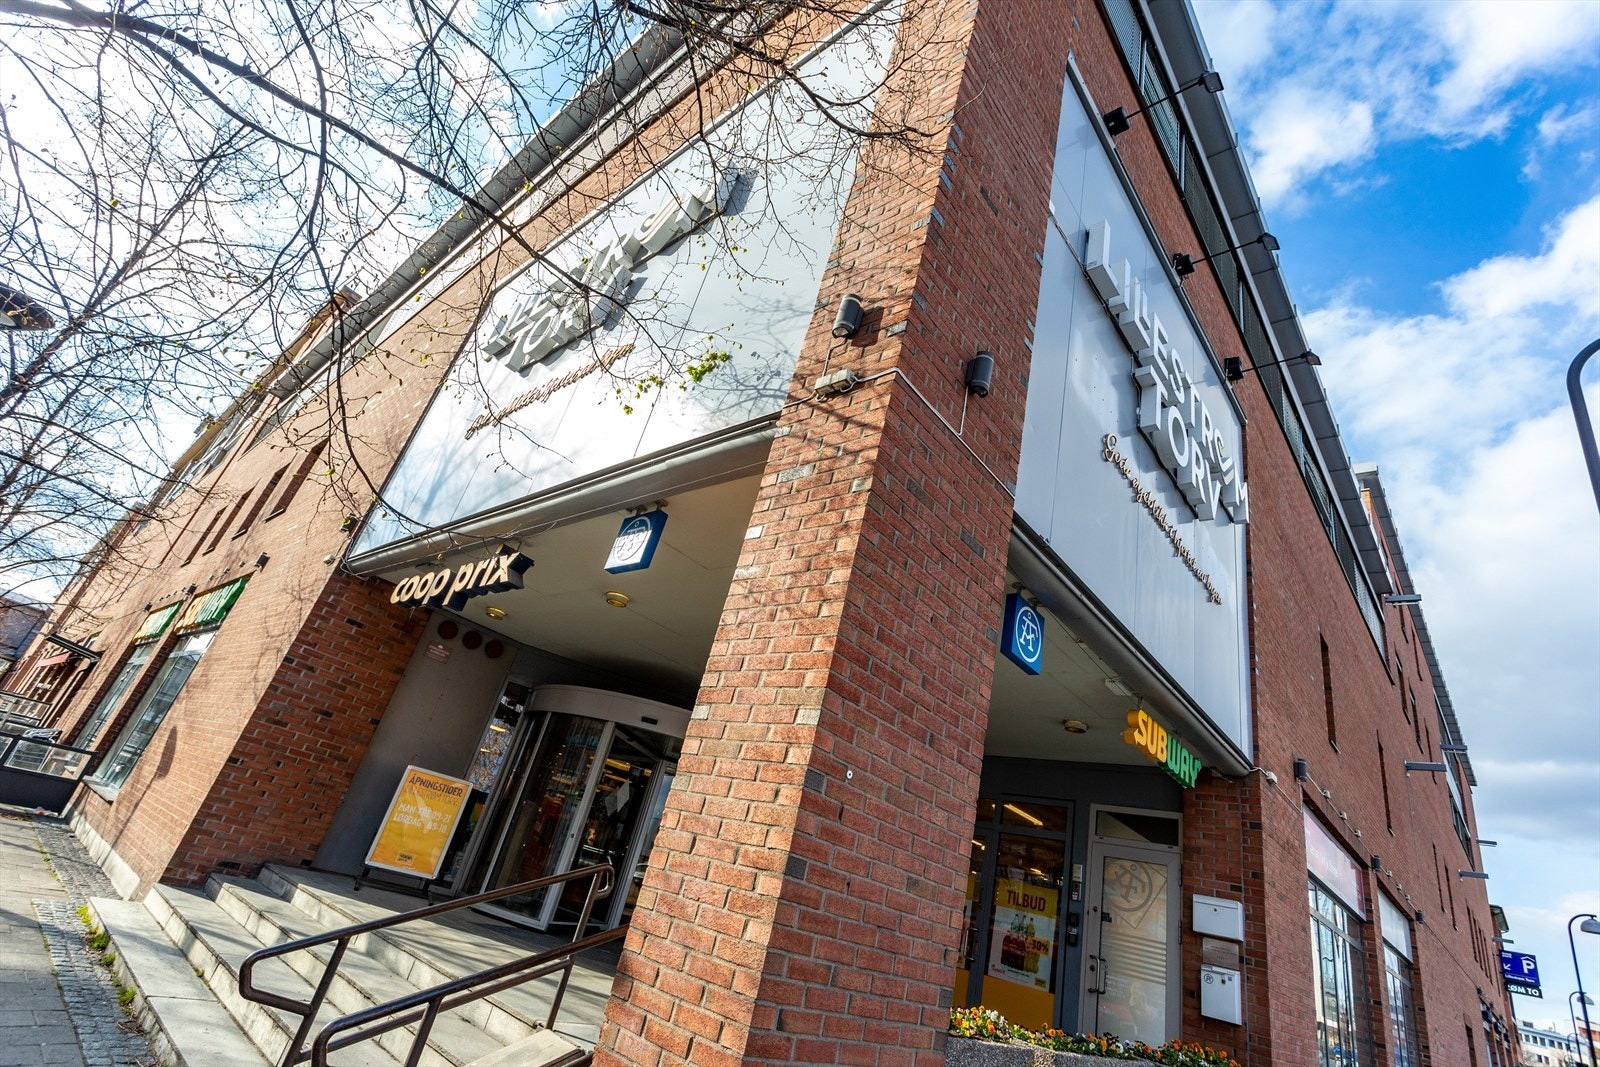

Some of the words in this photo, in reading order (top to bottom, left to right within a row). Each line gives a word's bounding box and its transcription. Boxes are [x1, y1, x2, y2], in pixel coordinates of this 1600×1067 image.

[1135, 364, 1221, 521] TORV
[390, 568, 451, 605] coop
[441, 543, 520, 606] prix
[1132, 709, 1202, 789] SUBWAY
[409, 774, 464, 798] ÅPNINGSTIDER
[393, 812, 422, 828] LØRDAG
[1007, 890, 1047, 912] TILBUD
[1521, 959, 1535, 973] P
